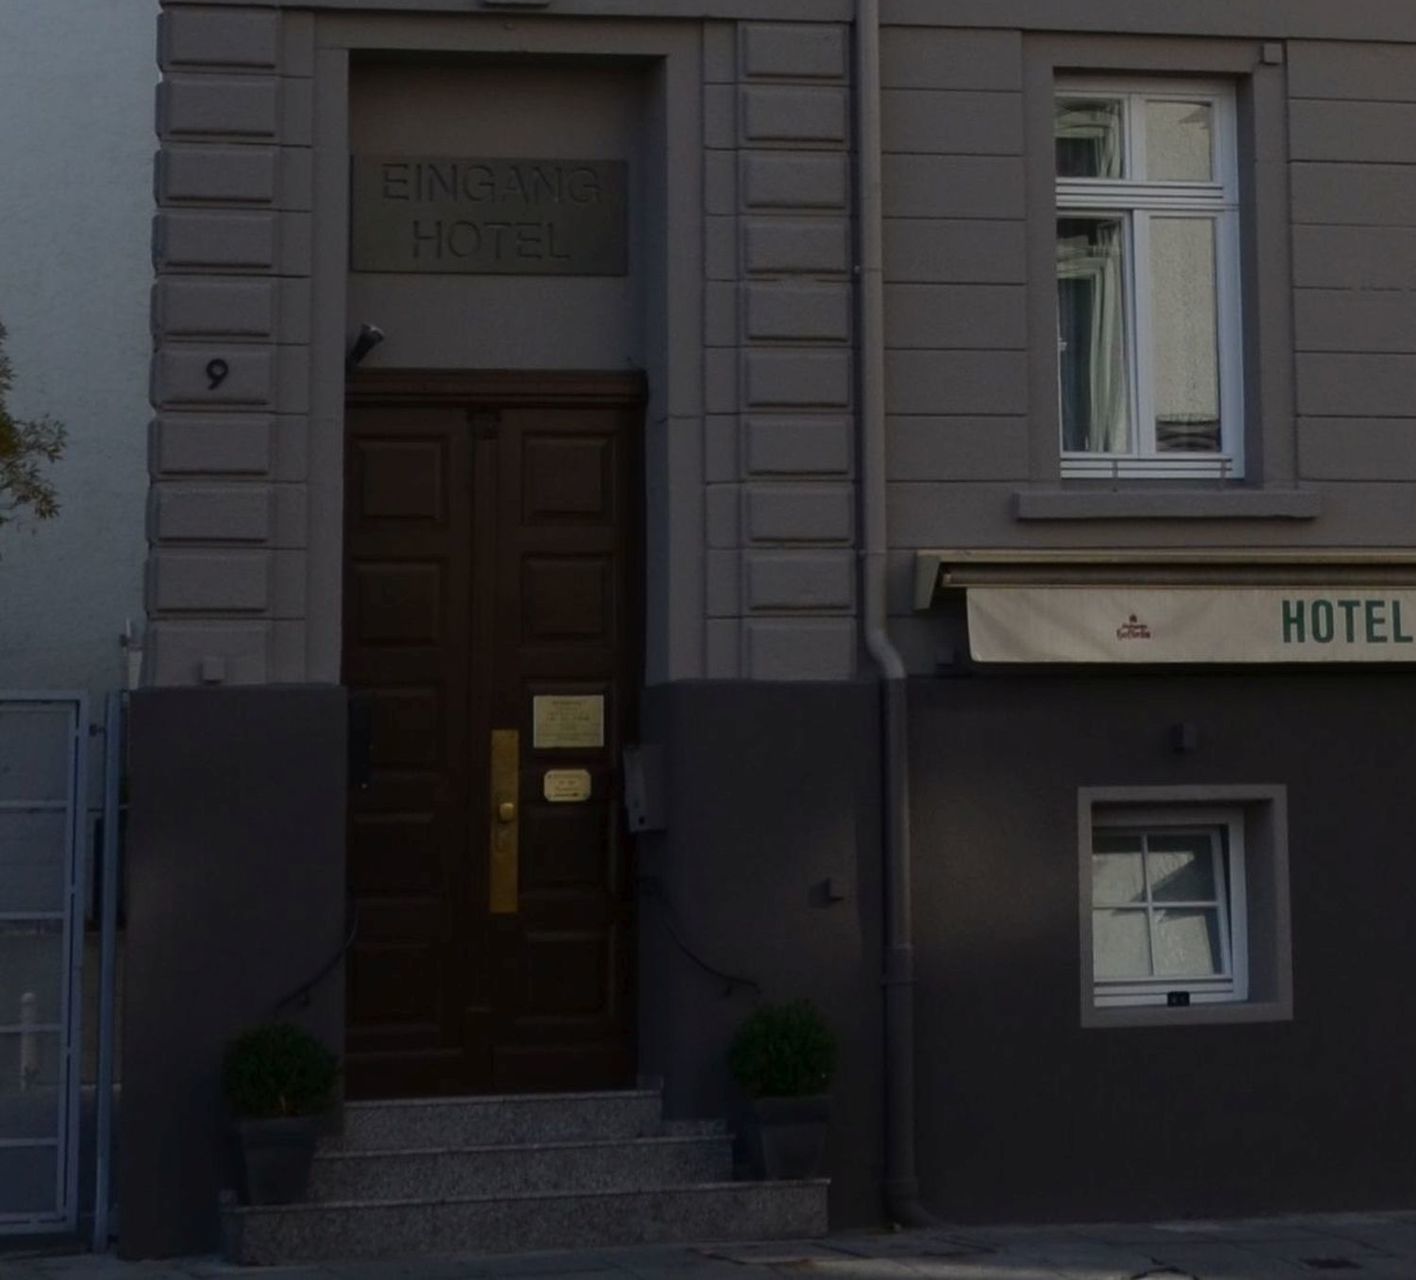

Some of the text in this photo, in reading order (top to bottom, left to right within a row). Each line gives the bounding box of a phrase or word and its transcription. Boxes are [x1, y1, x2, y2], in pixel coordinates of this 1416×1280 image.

[381, 162, 601, 204] EINGANG
[412, 220, 572, 261] HOTEL
[205, 359, 229, 389] 9
[1282, 599, 1412, 643] HOTEL
